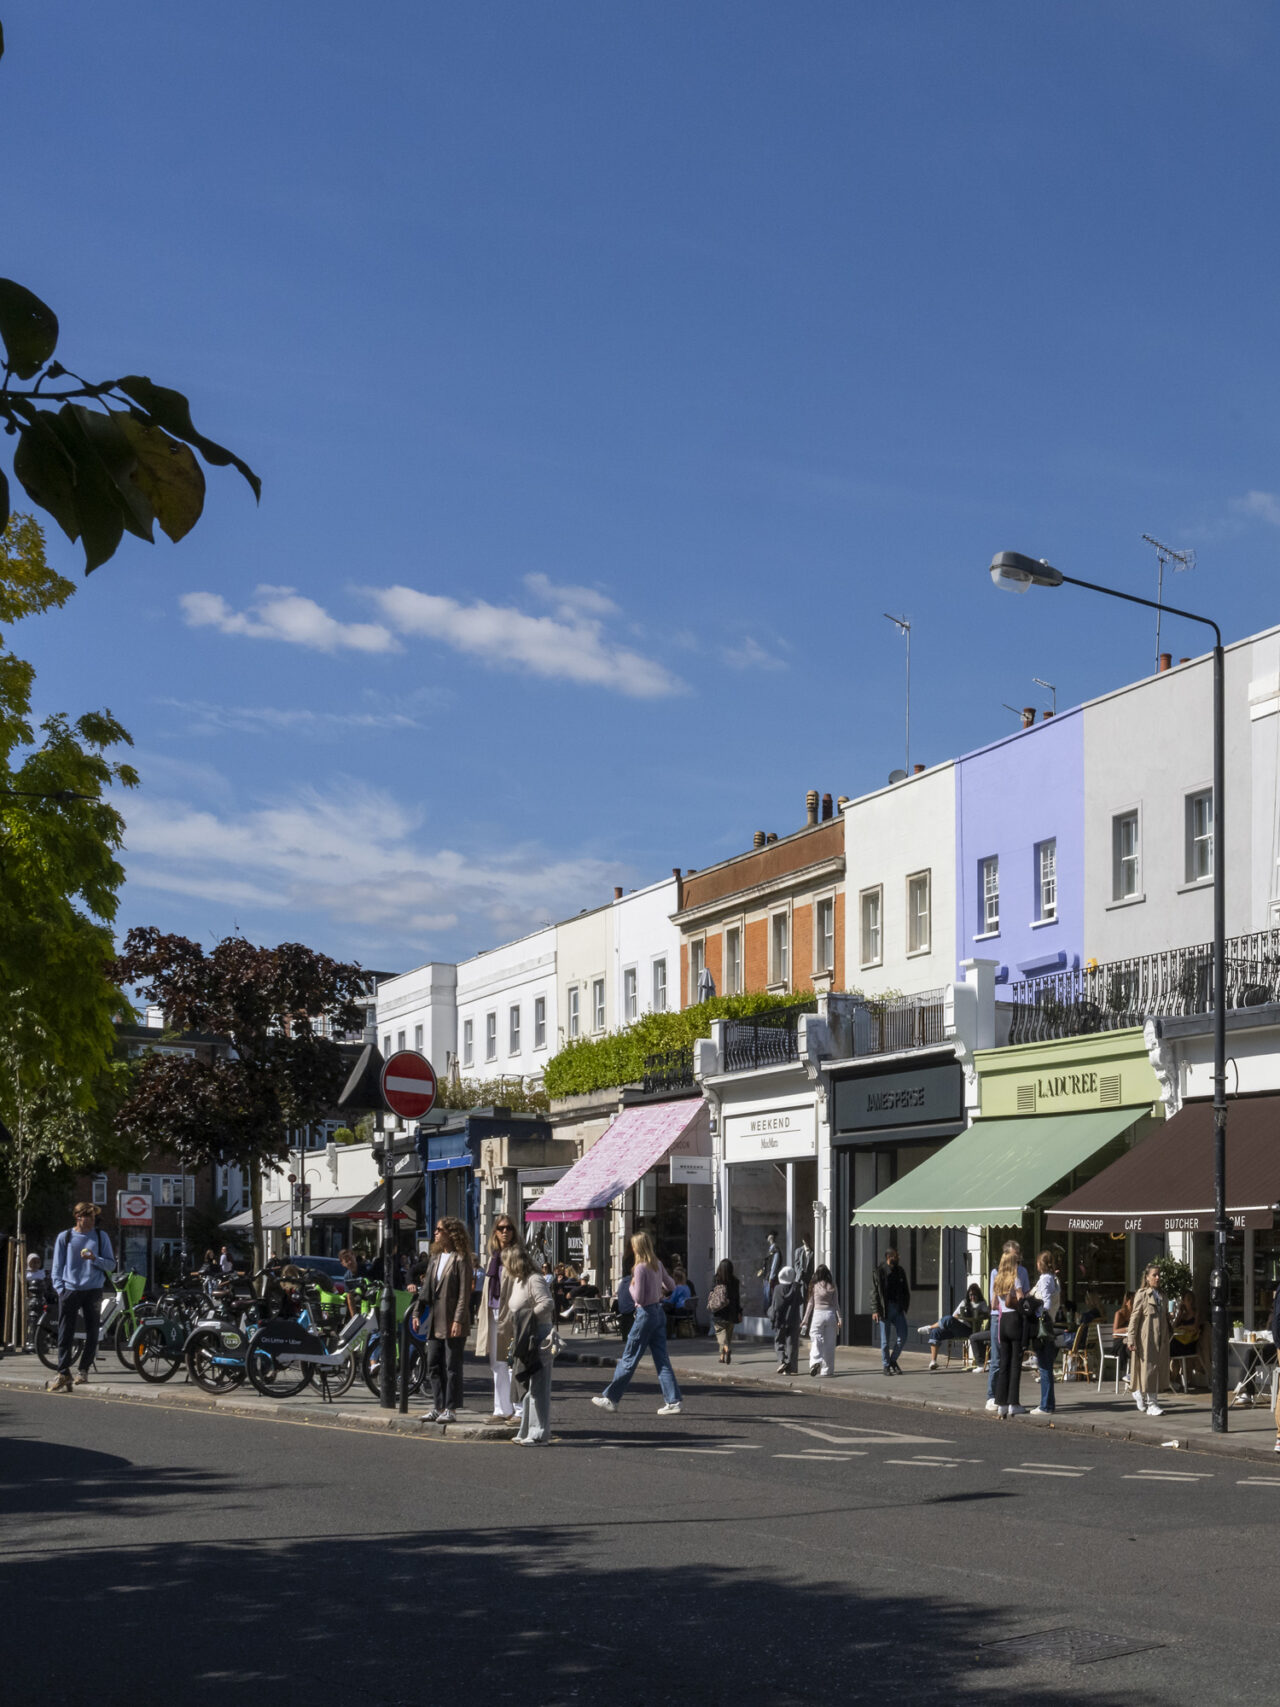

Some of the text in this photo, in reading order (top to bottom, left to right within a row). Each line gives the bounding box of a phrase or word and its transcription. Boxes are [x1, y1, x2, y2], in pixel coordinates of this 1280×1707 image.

[750, 1116, 791, 1132] WEEKEND
[1068, 1218, 1104, 1229] FARMSHOP
[1124, 1217, 1142, 1230] CAFÉ
[1164, 1217, 1199, 1229] BUTCHER
